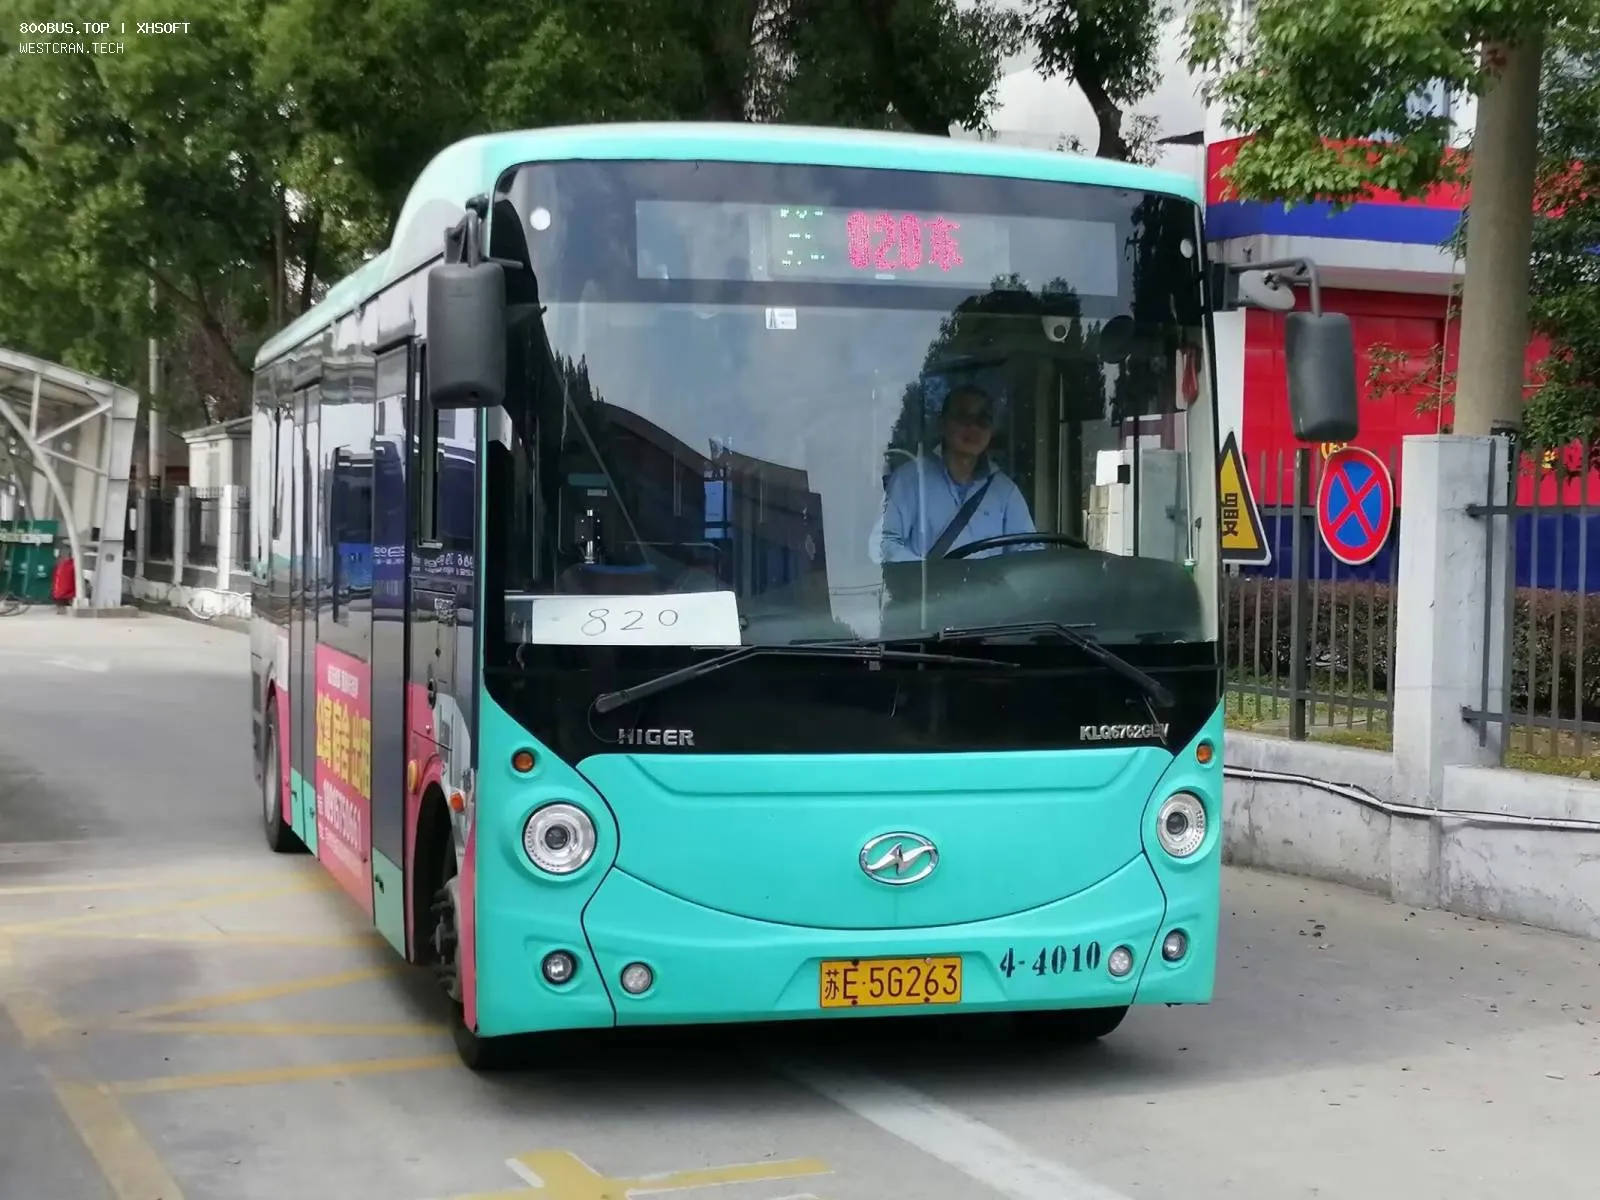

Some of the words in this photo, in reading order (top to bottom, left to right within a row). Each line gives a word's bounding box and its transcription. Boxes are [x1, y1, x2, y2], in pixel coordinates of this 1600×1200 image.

[580, 608, 679, 636] 820
[618, 728, 695, 746] HIGER
[1000, 941, 1101, 978] 4-4010
